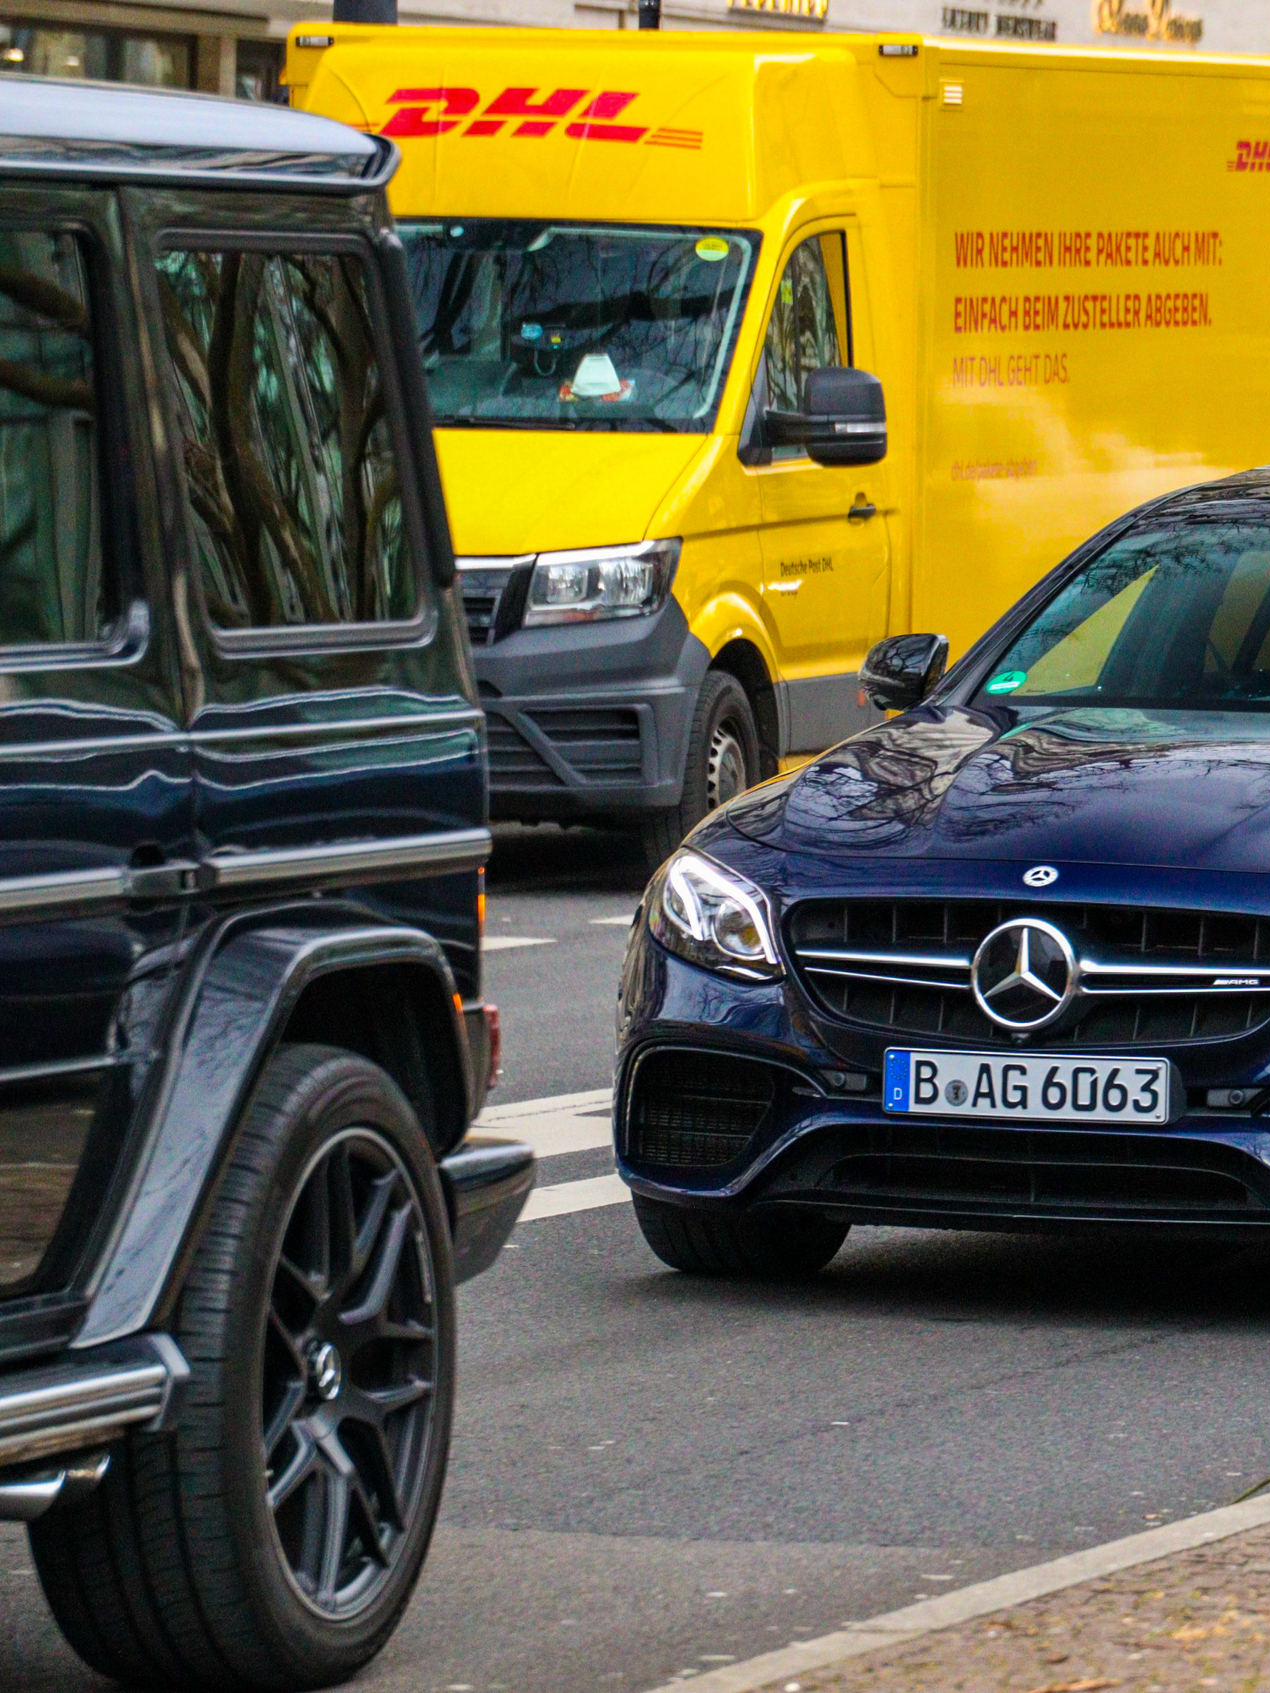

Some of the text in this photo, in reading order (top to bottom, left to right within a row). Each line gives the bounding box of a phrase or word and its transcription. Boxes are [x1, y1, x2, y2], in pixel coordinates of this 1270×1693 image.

[378, 88, 651, 143] DHL
[954, 231, 1223, 268] WIR NEHMEN IHRE PAKETE AUCH MIT:
[953, 293, 1212, 333] EINFACH BEIM ZUSTELLER ABGEBEN.
[952, 353, 1070, 387] MIT DHL GEHT DAS.
[780, 557, 834, 576] Deutsche Post DHL
[1002, 671, 1014, 682] 4
[893, 1087, 903, 1101] D
[914, 1059, 1160, 1114] B AG 6063
